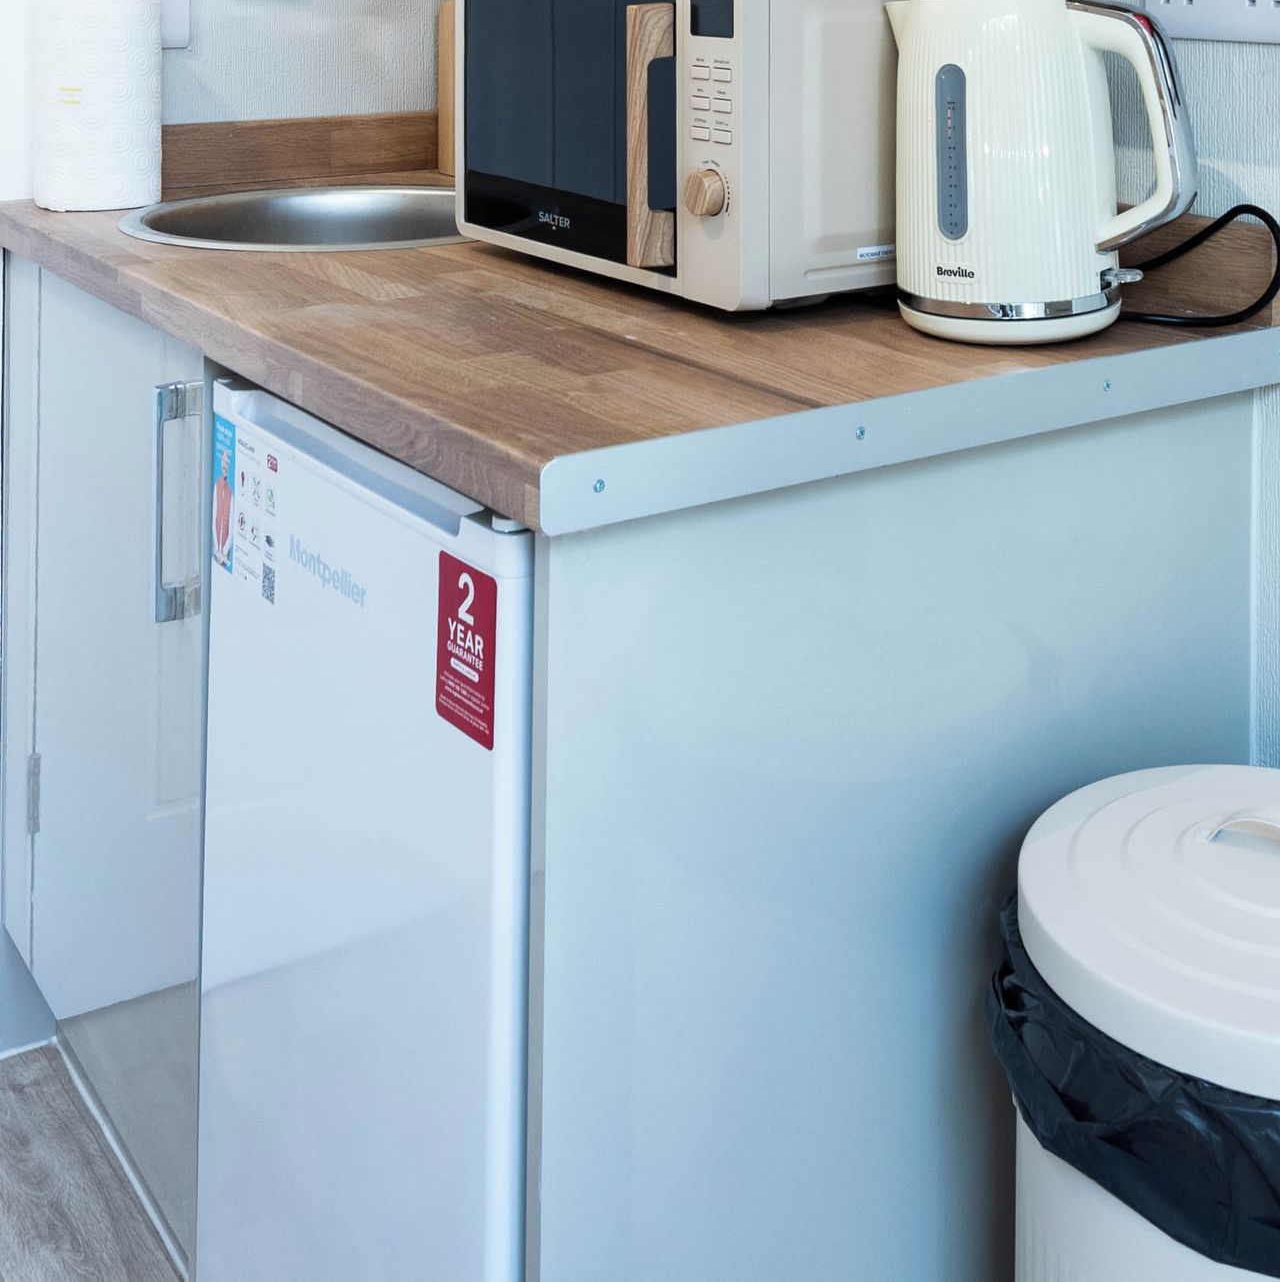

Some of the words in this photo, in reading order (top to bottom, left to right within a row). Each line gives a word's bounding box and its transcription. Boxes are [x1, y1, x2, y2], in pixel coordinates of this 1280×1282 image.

[538, 210, 570, 229] SALTER
[936, 266, 975, 279] Breville
[289, 533, 367, 608] Montpellier
[457, 572, 475, 627] 2
[446, 639, 484, 672] GUARANTEE
[447, 617, 484, 659] YEAR
